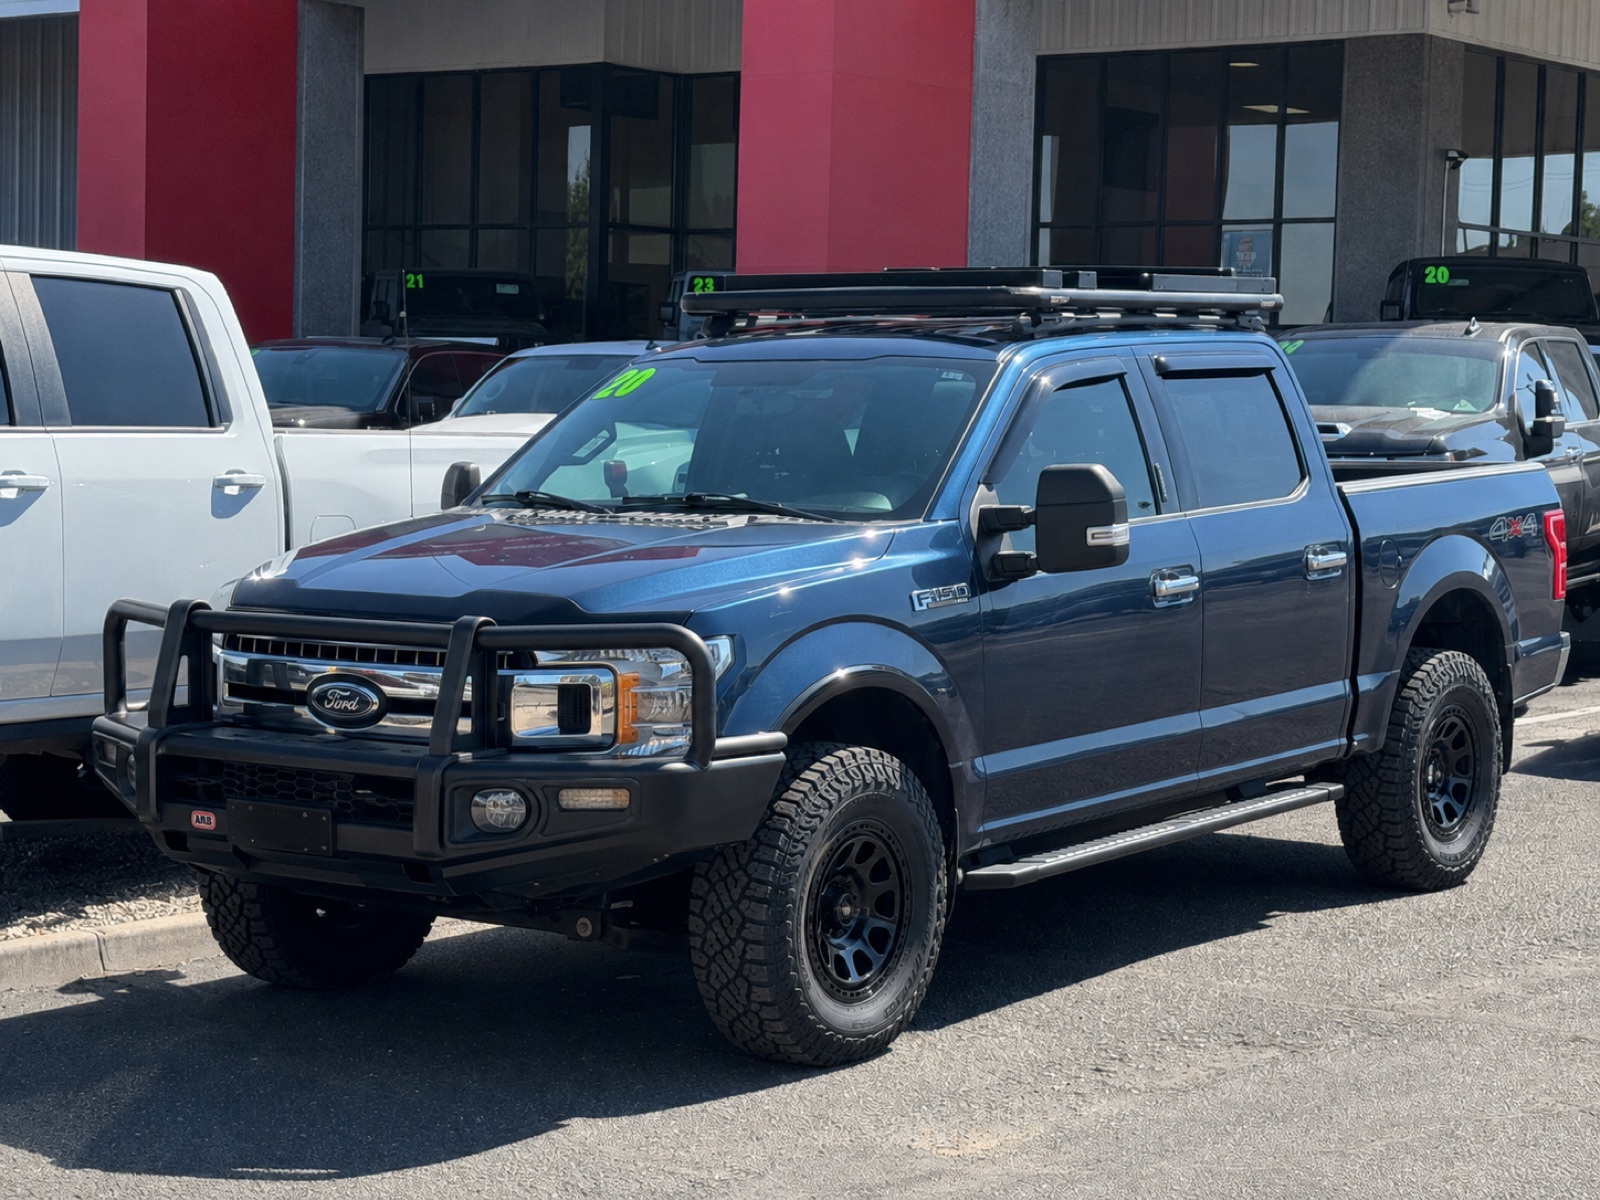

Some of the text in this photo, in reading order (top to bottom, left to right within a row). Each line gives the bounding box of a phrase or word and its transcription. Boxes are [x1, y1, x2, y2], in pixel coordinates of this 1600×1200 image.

[406, 273, 424, 289] 21
[1424, 265, 1450, 284] 20
[693, 277, 715, 293] 23
[592, 368, 656, 400] 20
[324, 689, 360, 710] Ford
